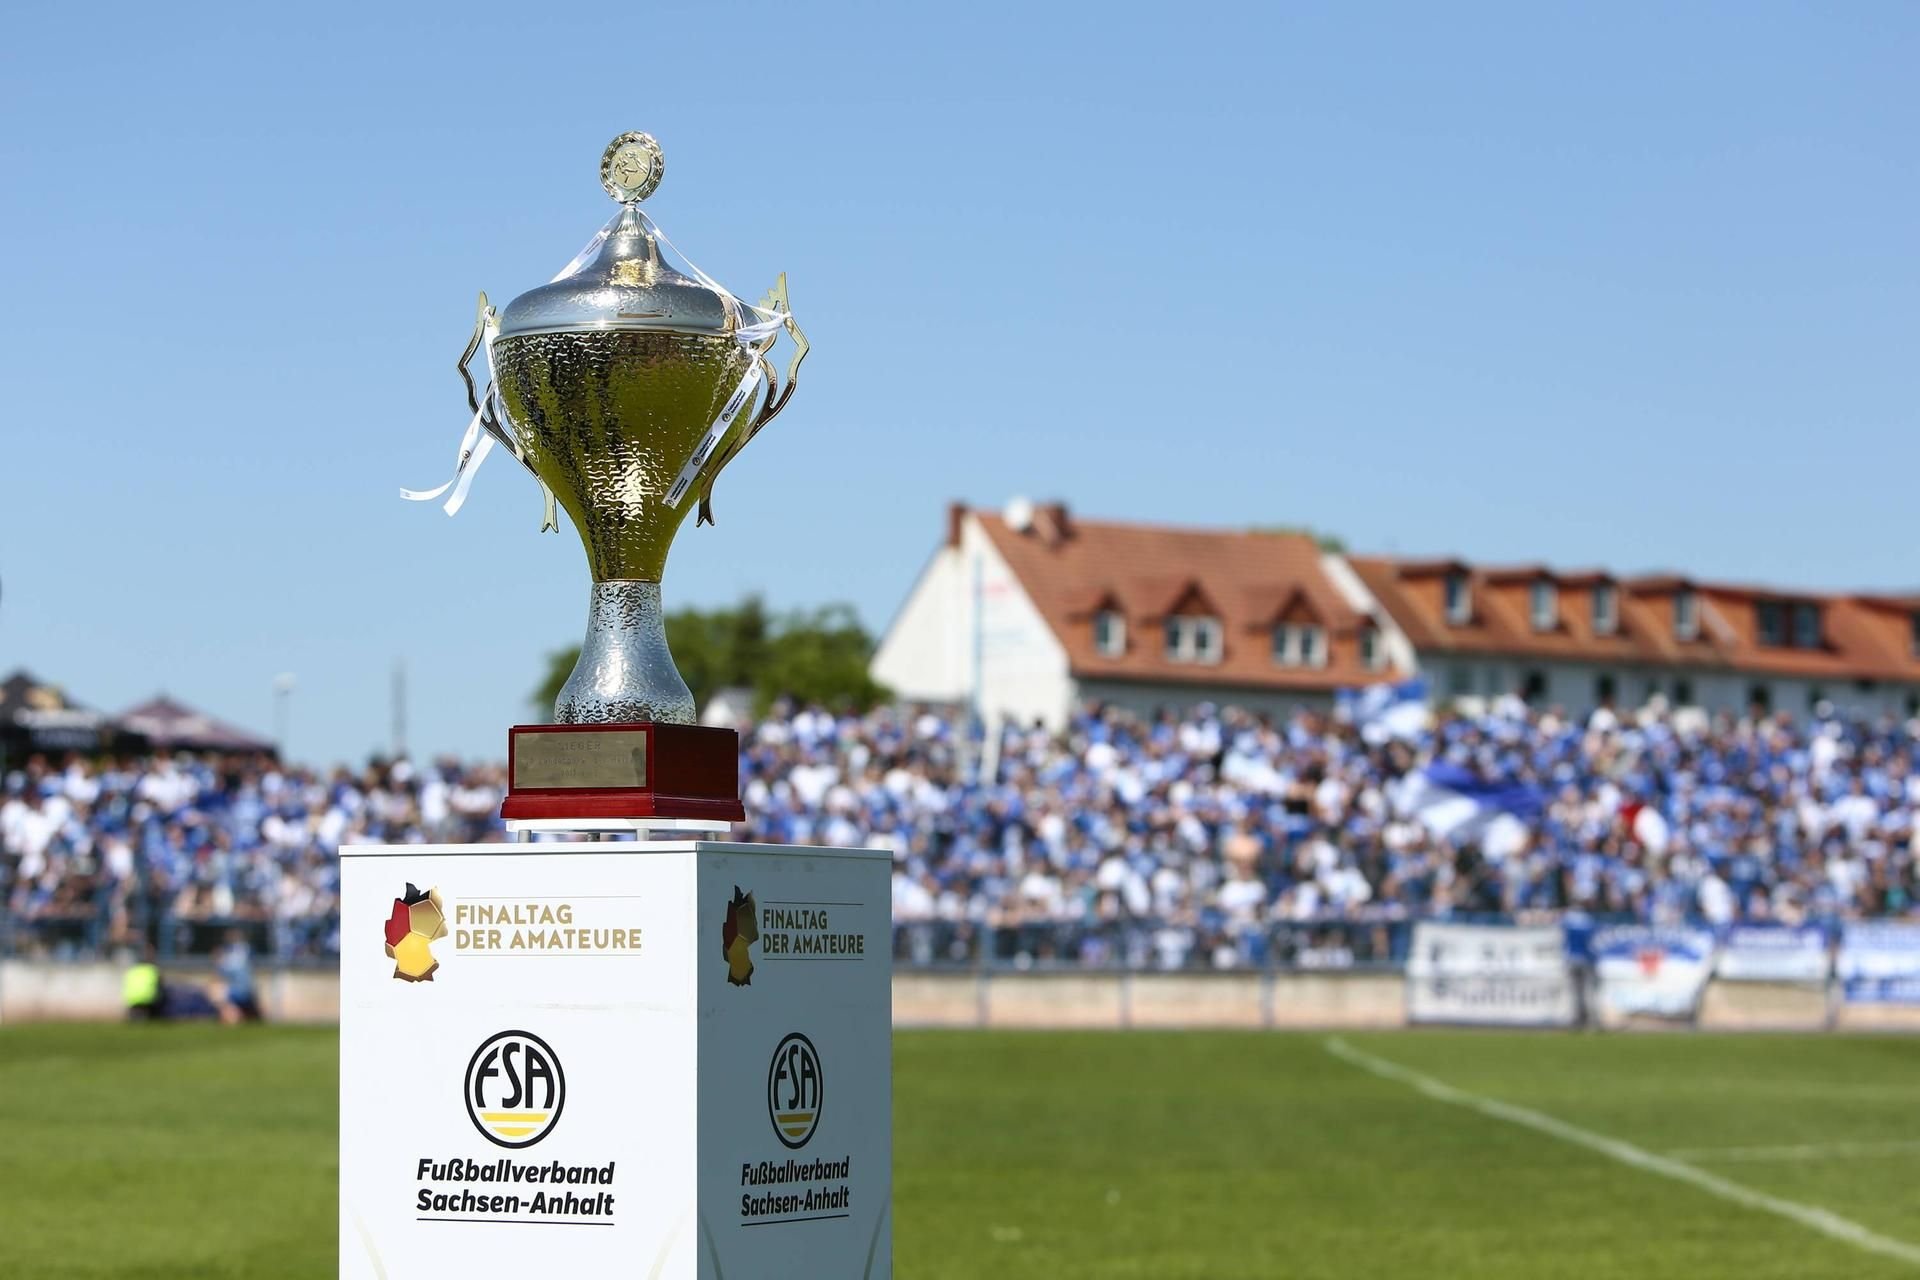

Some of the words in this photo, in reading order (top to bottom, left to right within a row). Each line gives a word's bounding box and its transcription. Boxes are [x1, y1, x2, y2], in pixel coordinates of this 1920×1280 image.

[456, 904, 573, 925] FINALTAG
[763, 908, 828, 930] FINALTAG
[456, 929, 502, 950] DER
[509, 929, 642, 950] AMATEURE
[763, 933, 789, 954] DER
[792, 934, 865, 955] AMATEURE
[475, 1042, 555, 1109] FSA
[773, 1044, 817, 1110] FSA
[416, 1157, 615, 1186] Fußballverband
[741, 1155, 850, 1186] Fußballverband
[416, 1188, 615, 1216] Sachsen-Anhalt
[741, 1186, 850, 1217] Sachsen-Anhalt
